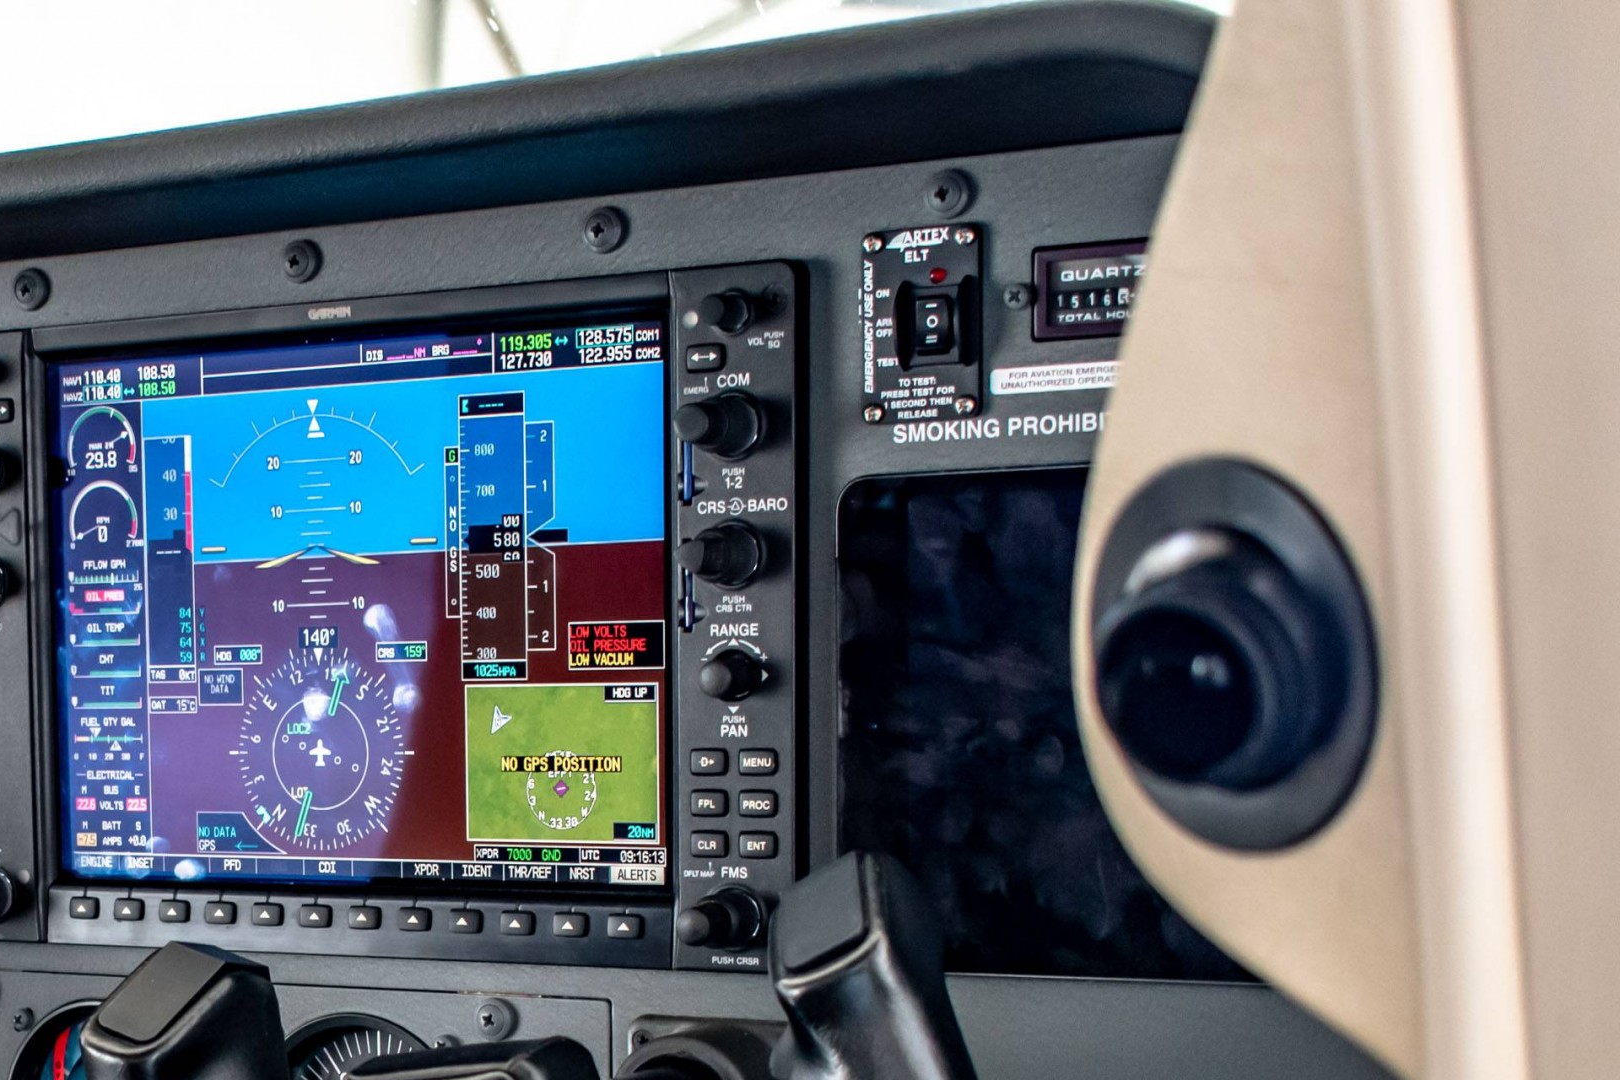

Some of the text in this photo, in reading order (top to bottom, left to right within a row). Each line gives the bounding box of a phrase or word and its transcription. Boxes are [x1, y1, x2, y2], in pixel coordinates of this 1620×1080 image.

[903, 227, 950, 245] ARTEX
[904, 249, 929, 263] ELT
[1061, 265, 1146, 282] QUARTZ
[876, 289, 890, 298] ON
[308, 306, 352, 319] GARMIN
[1057, 312, 1101, 323] TOTAL
[864, 260, 873, 394] EMERGENCY USE ONLY
[500, 327, 659, 352] 119.305 128.575 COM1
[500, 345, 661, 369] 127.730 122.955 COM2
[63, 364, 175, 386] NAV1 110.40 108.50
[717, 373, 750, 387] COM
[1009, 371, 1029, 380] FOR
[1031, 369, 1073, 378] AVIATION
[898, 378, 911, 388] TO
[1001, 378, 1075, 390] UNAUTHORIZED
[63, 381, 176, 402] NAV2 110.40 108.50
[881, 386, 955, 399] PRESS TEST FOR
[891, 399, 927, 410] SECOND
[930, 396, 952, 407] THEN
[898, 409, 938, 419] RELEASE
[893, 418, 1000, 443] SMOKING
[474, 443, 495, 456] 800
[85, 451, 117, 469] 29.8
[162, 469, 177, 482] 40
[725, 477, 743, 489] 1-2
[697, 501, 726, 515] CRS
[747, 498, 788, 512] BARO
[163, 507, 179, 521] 30
[83, 559, 126, 570] FFLOW GPH
[475, 564, 500, 579] 500
[87, 622, 125, 633] OIL TEMP
[570, 625, 627, 639] LOW VOLTS
[710, 623, 759, 638] RANGE
[303, 628, 335, 646] 140°
[570, 638, 647, 652] OIL PRESSURE
[99, 654, 115, 664] CHT
[570, 653, 634, 667] LOW VACUUM
[612, 687, 647, 699] HDG UP
[720, 724, 748, 738] PAN
[501, 756, 622, 772] NO GPS POSITION
[743, 757, 772, 768] MENU
[87, 770, 134, 780] ELECTRICAL
[698, 799, 715, 809] FPL
[742, 800, 770, 811] PROC
[198, 826, 237, 837] NO DATA
[198, 840, 216, 851] GPS
[697, 840, 717, 850] CLR
[746, 841, 766, 851] ENT
[476, 848, 561, 861] XPDR 7000 GND
[581, 849, 665, 863] UTC 09:16:13
[80, 857, 113, 867] ENGINE
[224, 859, 242, 871] PFD
[318, 861, 336, 874] CDI
[414, 863, 439, 876] XPDR
[461, 865, 493, 877] IDENT
[509, 866, 552, 879] TMR/REF
[569, 868, 595, 880] NRST
[617, 869, 657, 881] ALERTS
[721, 866, 748, 879] FMS
